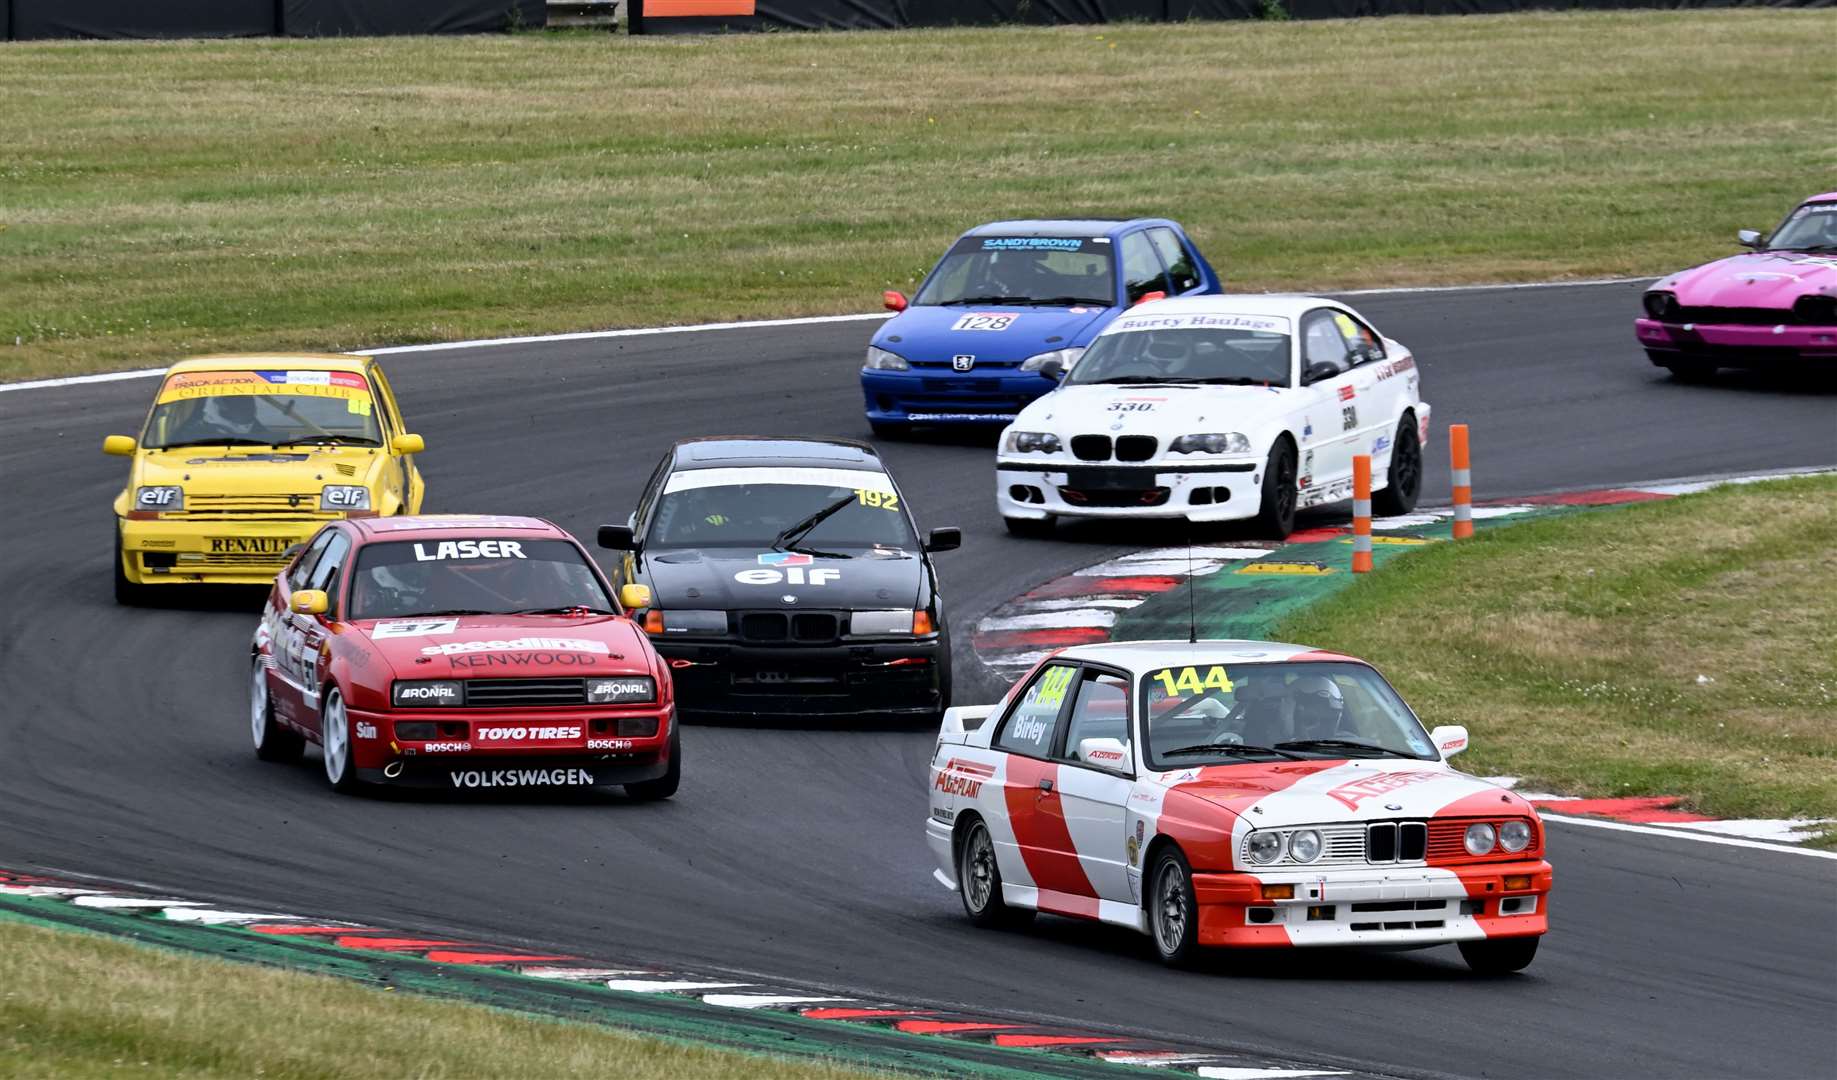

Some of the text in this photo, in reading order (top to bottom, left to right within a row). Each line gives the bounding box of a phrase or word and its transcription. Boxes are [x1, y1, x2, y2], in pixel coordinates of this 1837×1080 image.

[984, 239, 1082, 247] SANDYBROWN
[961, 316, 1011, 330] 128
[1191, 317, 1275, 329] Haulage
[174, 377, 257, 389] TRACK ACTION
[178, 383, 351, 399] ORIENTAL CLUB
[140, 487, 177, 504] elf
[327, 486, 365, 504] elf
[855, 488, 899, 512] 192
[211, 538, 293, 552] RENAULT
[413, 540, 527, 562] LASER
[386, 622, 448, 634] 37
[449, 652, 596, 669] KENWOOD
[1153, 665, 1234, 697] 144
[477, 726, 582, 741] TOYO TIRES
[1013, 714, 1047, 745] Birley
[425, 743, 463, 753] BOSCH
[587, 740, 623, 750] BOSCH
[450, 768, 594, 788] VOLKSWAGEN
